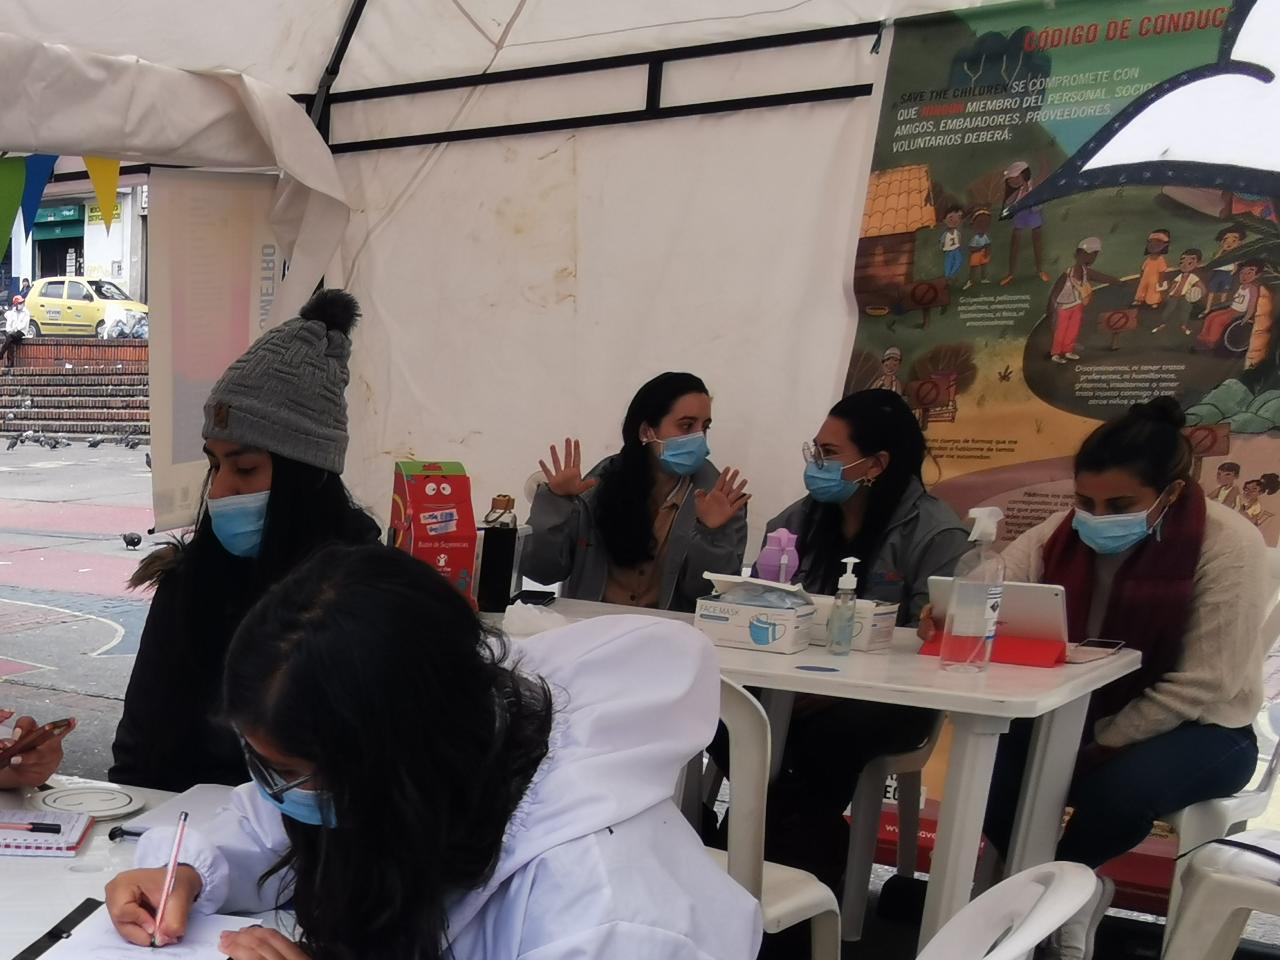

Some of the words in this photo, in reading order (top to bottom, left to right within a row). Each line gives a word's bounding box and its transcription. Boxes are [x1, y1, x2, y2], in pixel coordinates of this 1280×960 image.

[1024, 23, 1099, 53] CÓDIGO
[1105, 19, 1131, 41] DE
[1139, 7, 1233, 38] CONDUC
[900, 90, 927, 103] SAVE
[929, 89, 949, 100] THE
[953, 82, 1008, 98] CHILDREN
[1011, 80, 1027, 94] SE
[1029, 70, 1109, 91] COMPROMETE
[1113, 67, 1139, 81] CON
[897, 107, 919, 120] QUE
[966, 98, 1019, 113] MIEMBRO
[1022, 95, 1044, 109] DEL
[893, 133, 961, 153] VOLUNTARIOS
[964, 128, 1012, 145] DEBERÁ:
[894, 120, 936, 137] AMIGOS,
[700, 604, 719, 614] FACE
[720, 606, 739, 616] MASK
